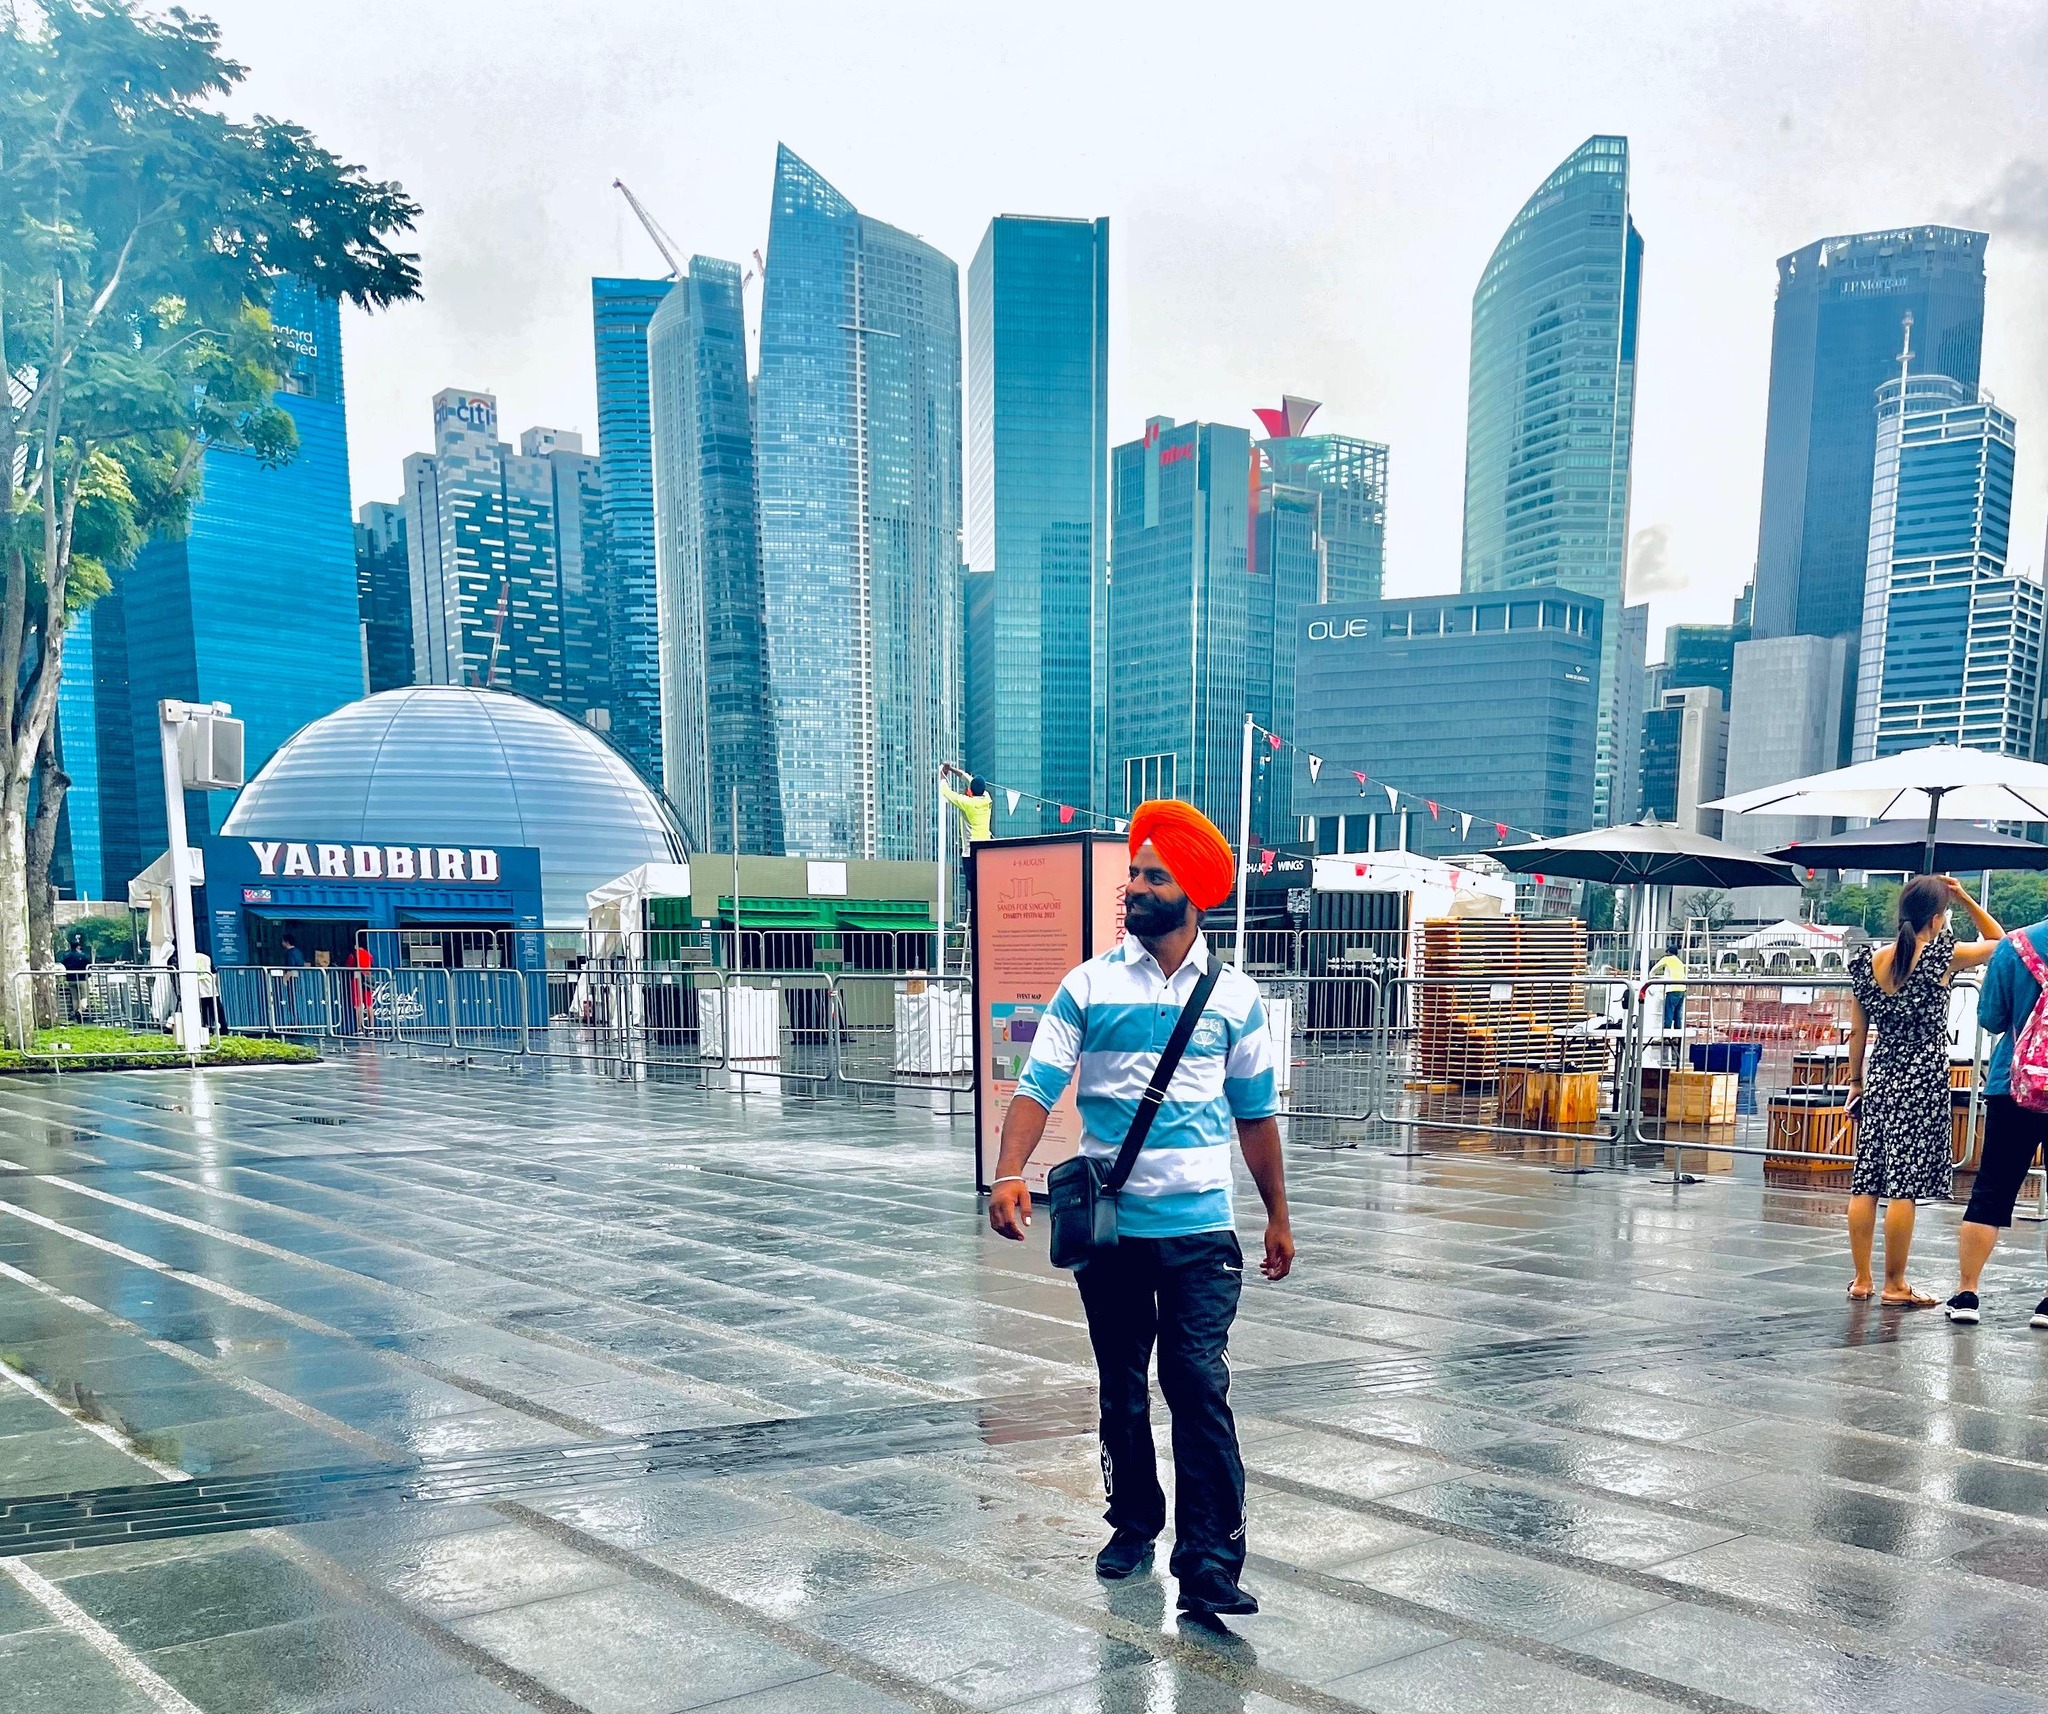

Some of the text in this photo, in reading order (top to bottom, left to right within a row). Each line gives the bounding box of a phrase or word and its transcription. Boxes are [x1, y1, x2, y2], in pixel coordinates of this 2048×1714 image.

[457, 402, 490, 425] citi
[1308, 618, 1369, 640] OUE
[248, 841, 499, 881] YARDBIRD
[1023, 858, 1046, 867] AUGUST
[1277, 860, 1304, 872] WINGS
[997, 902, 1062, 911] SANDS FOR SINGAPORE
